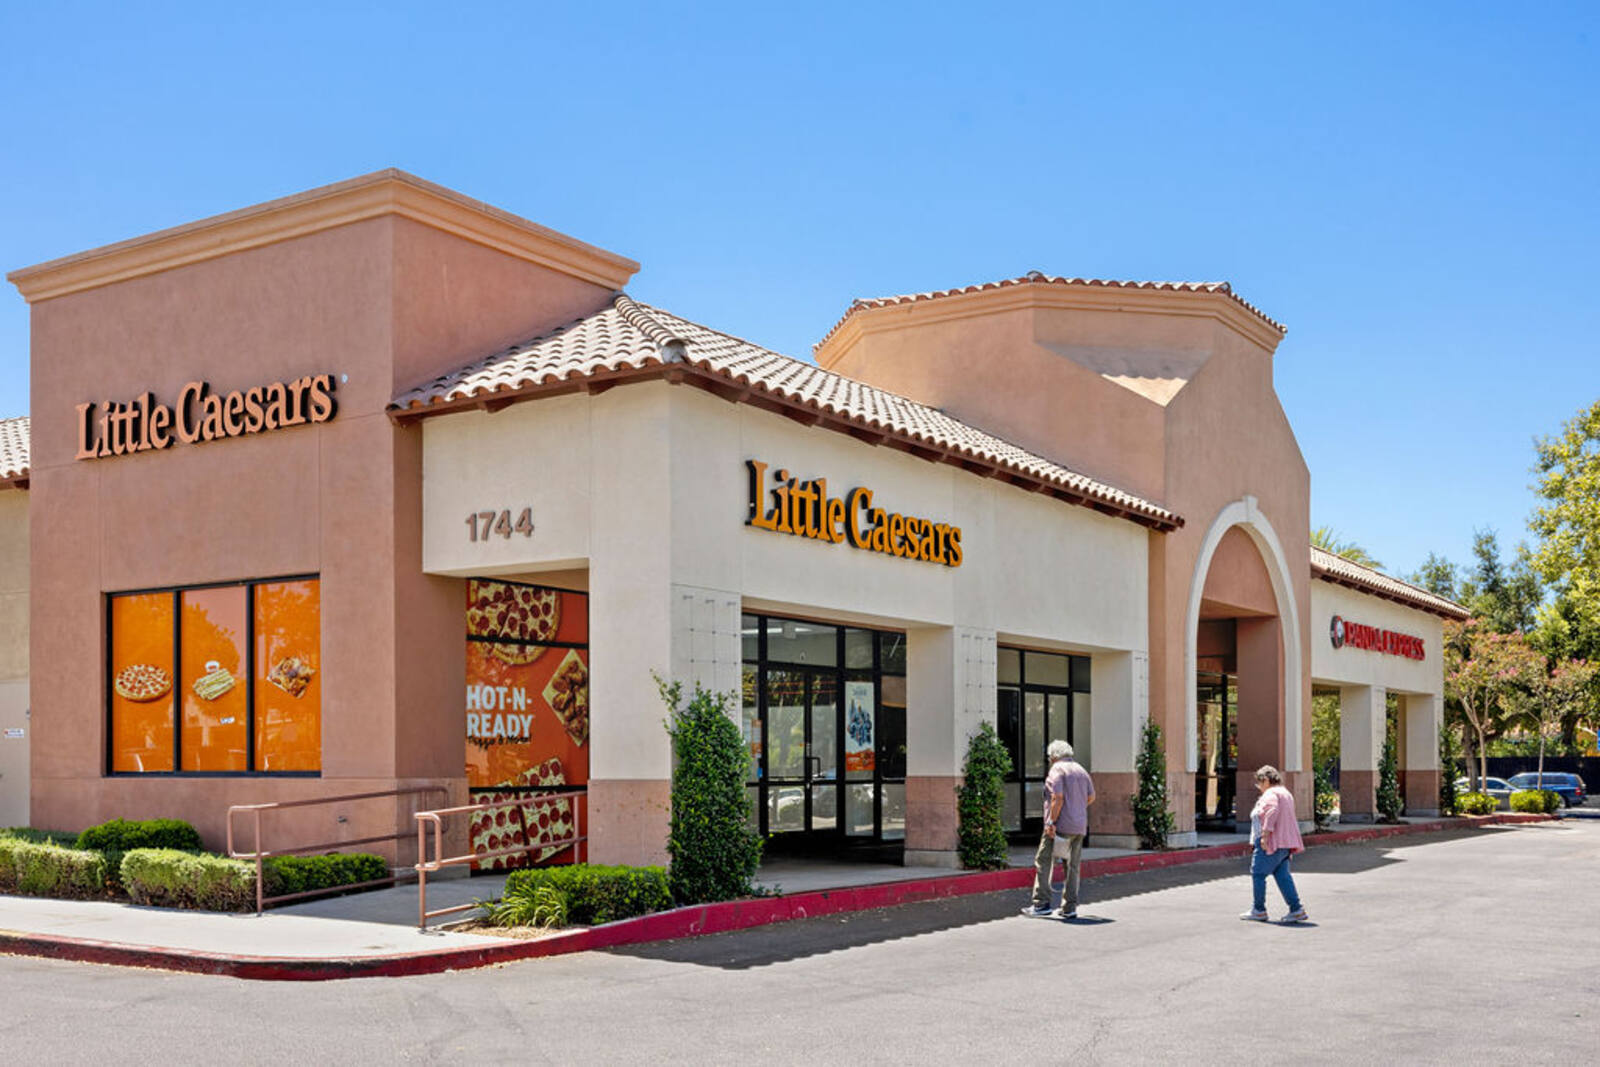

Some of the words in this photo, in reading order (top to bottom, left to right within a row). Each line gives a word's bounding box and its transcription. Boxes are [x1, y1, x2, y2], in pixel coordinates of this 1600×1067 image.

[74, 392, 174, 460] Little
[175, 374, 338, 443] Caesars
[465, 507, 535, 542] 1744
[745, 459, 846, 544] Little
[846, 486, 963, 567] Caesars
[1343, 621, 1382, 653] PANDA
[1382, 629, 1425, 661] EXPRESS
[466, 685, 533, 710] HOT-N-
[466, 713, 534, 738] READY
